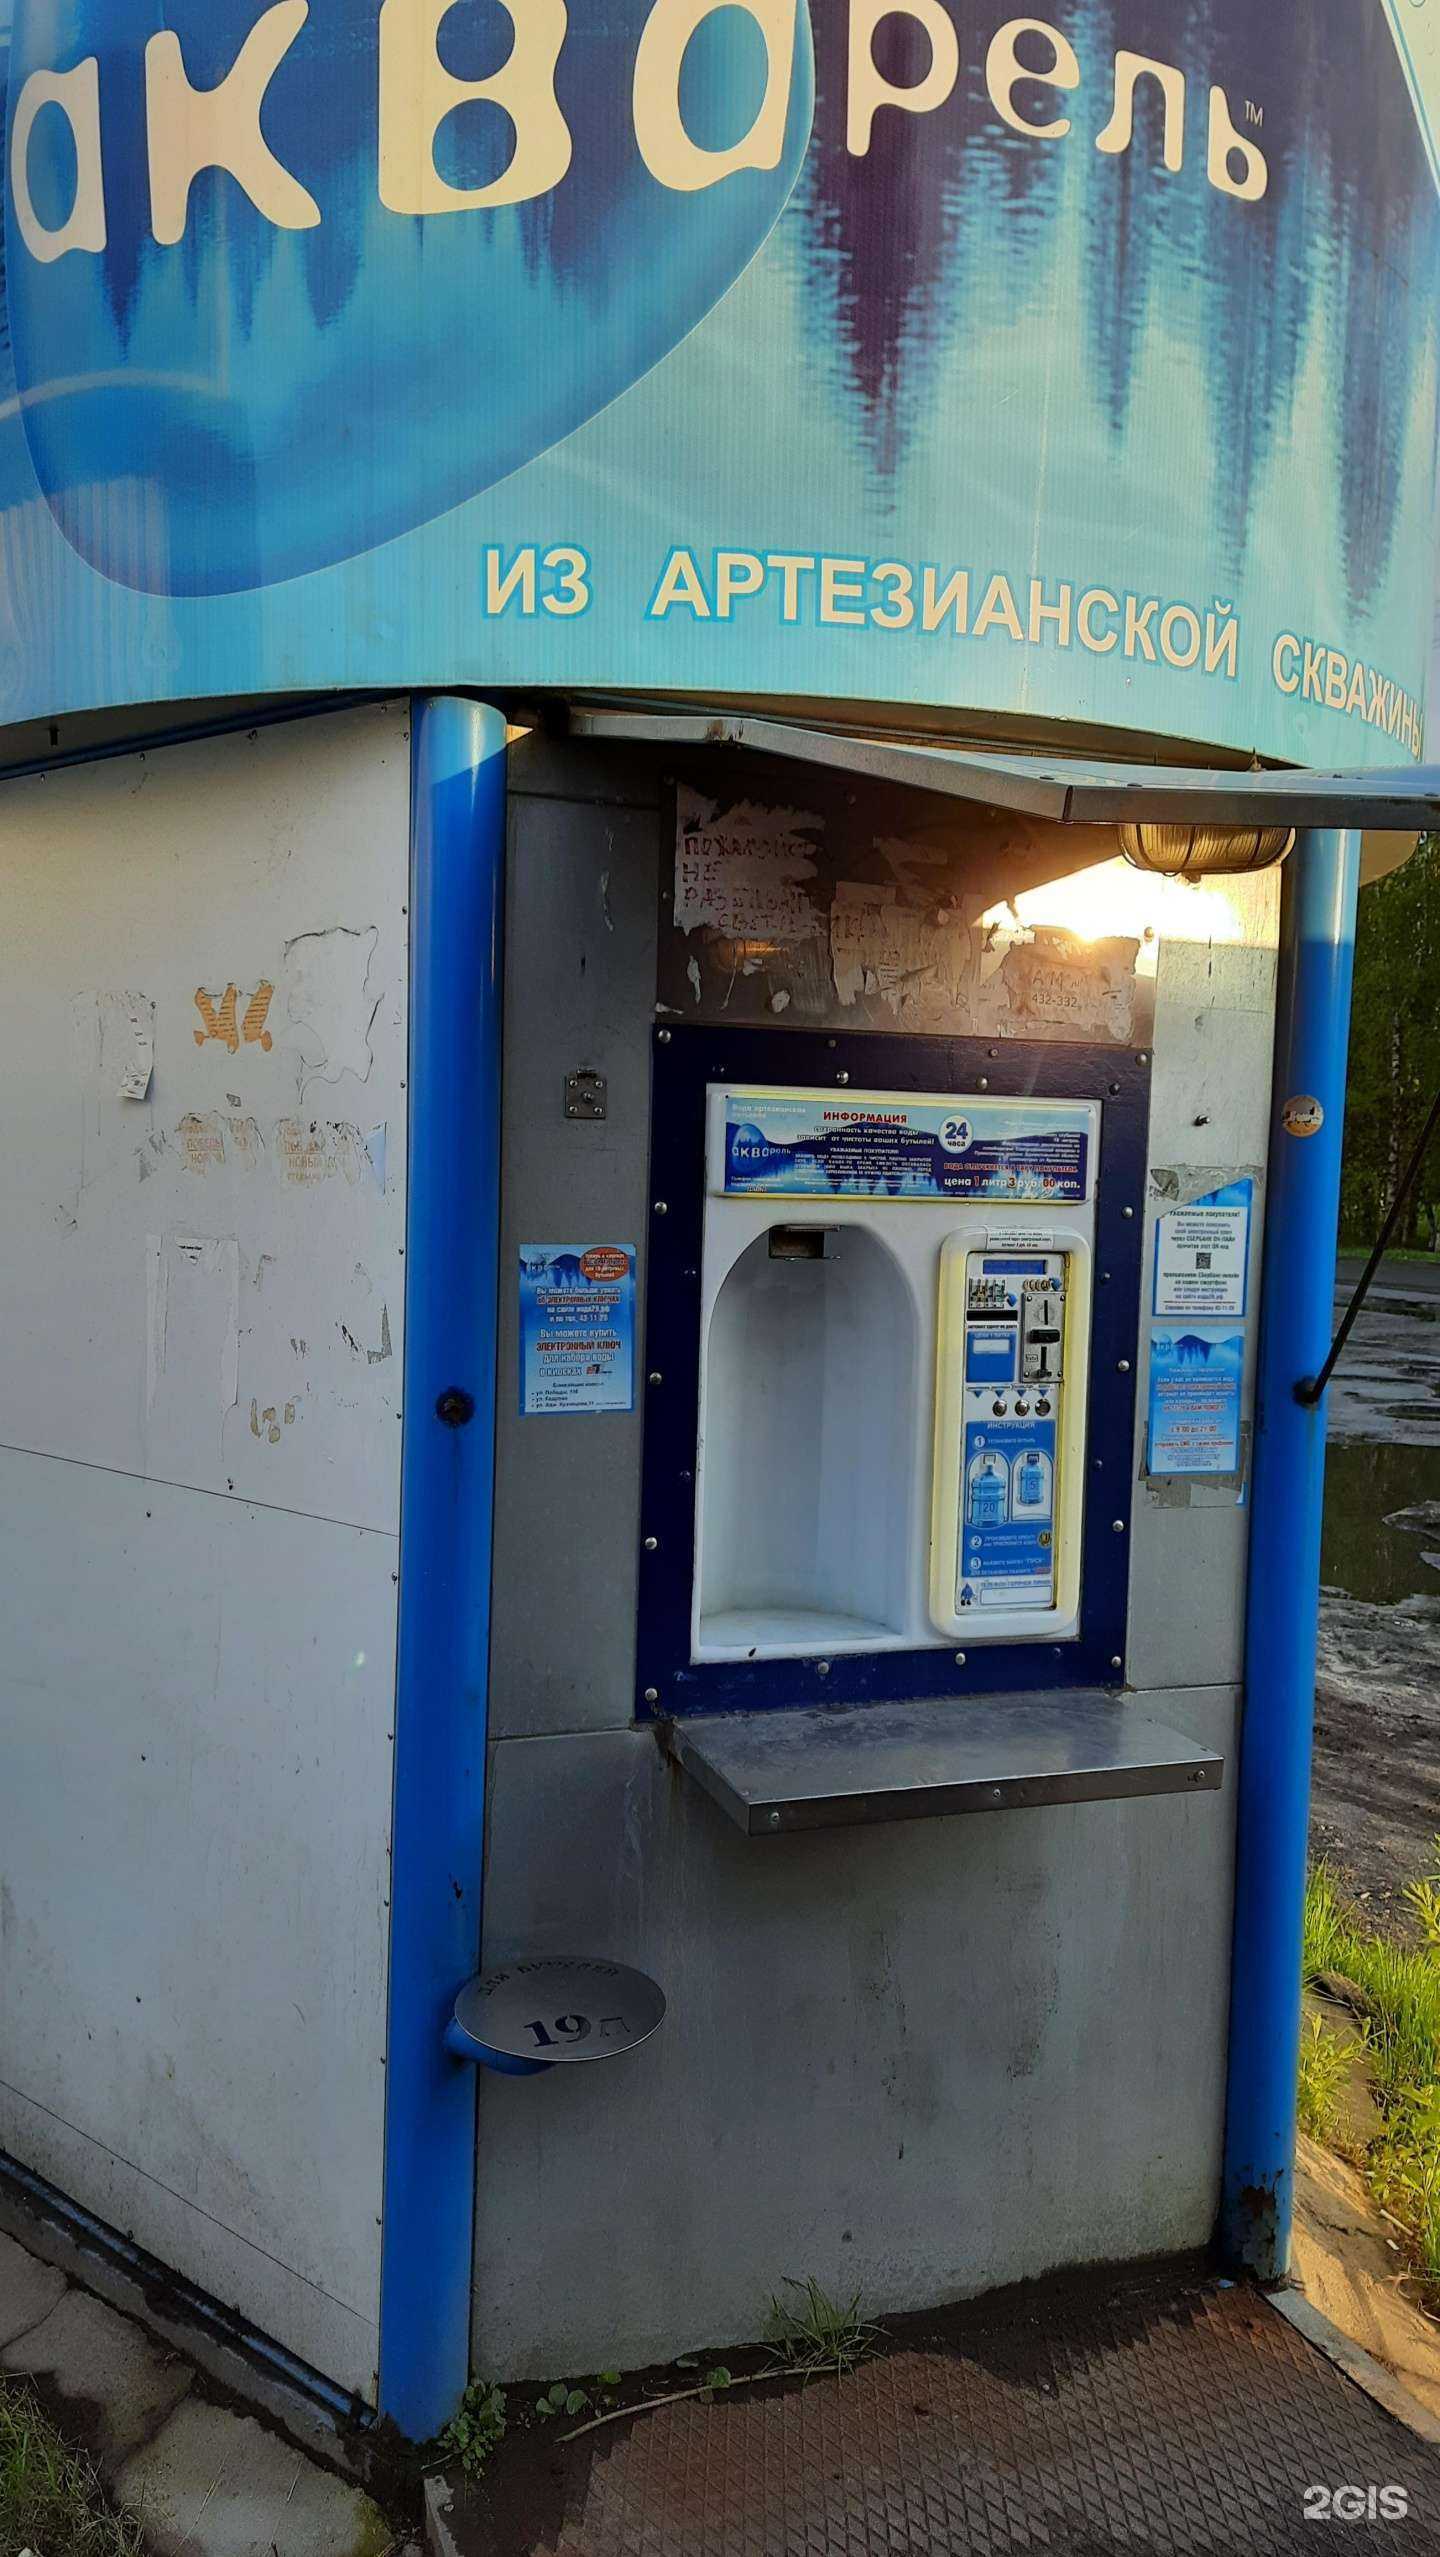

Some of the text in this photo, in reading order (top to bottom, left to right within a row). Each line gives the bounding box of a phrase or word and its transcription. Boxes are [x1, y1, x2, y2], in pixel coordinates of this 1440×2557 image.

[485, 546, 1425, 762] ИЗ АРТЕЗИАНСКОЙ СКВАЖИНЫ
[823, 1111, 908, 1124] ИНФОРМАЦИЯ
[945, 1121, 969, 1140] 24
[947, 1140, 966, 1150] часа
[944, 1178, 971, 1189] цена
[1009, 1177, 1017, 1188] 3
[1057, 1180, 1080, 1189] коп.
[597, 1340, 621, 1350] КЛЮЧ
[987, 1420, 1036, 1431] ИНСТРУКЦИЯ
[984, 1502, 996, 1513] 20
